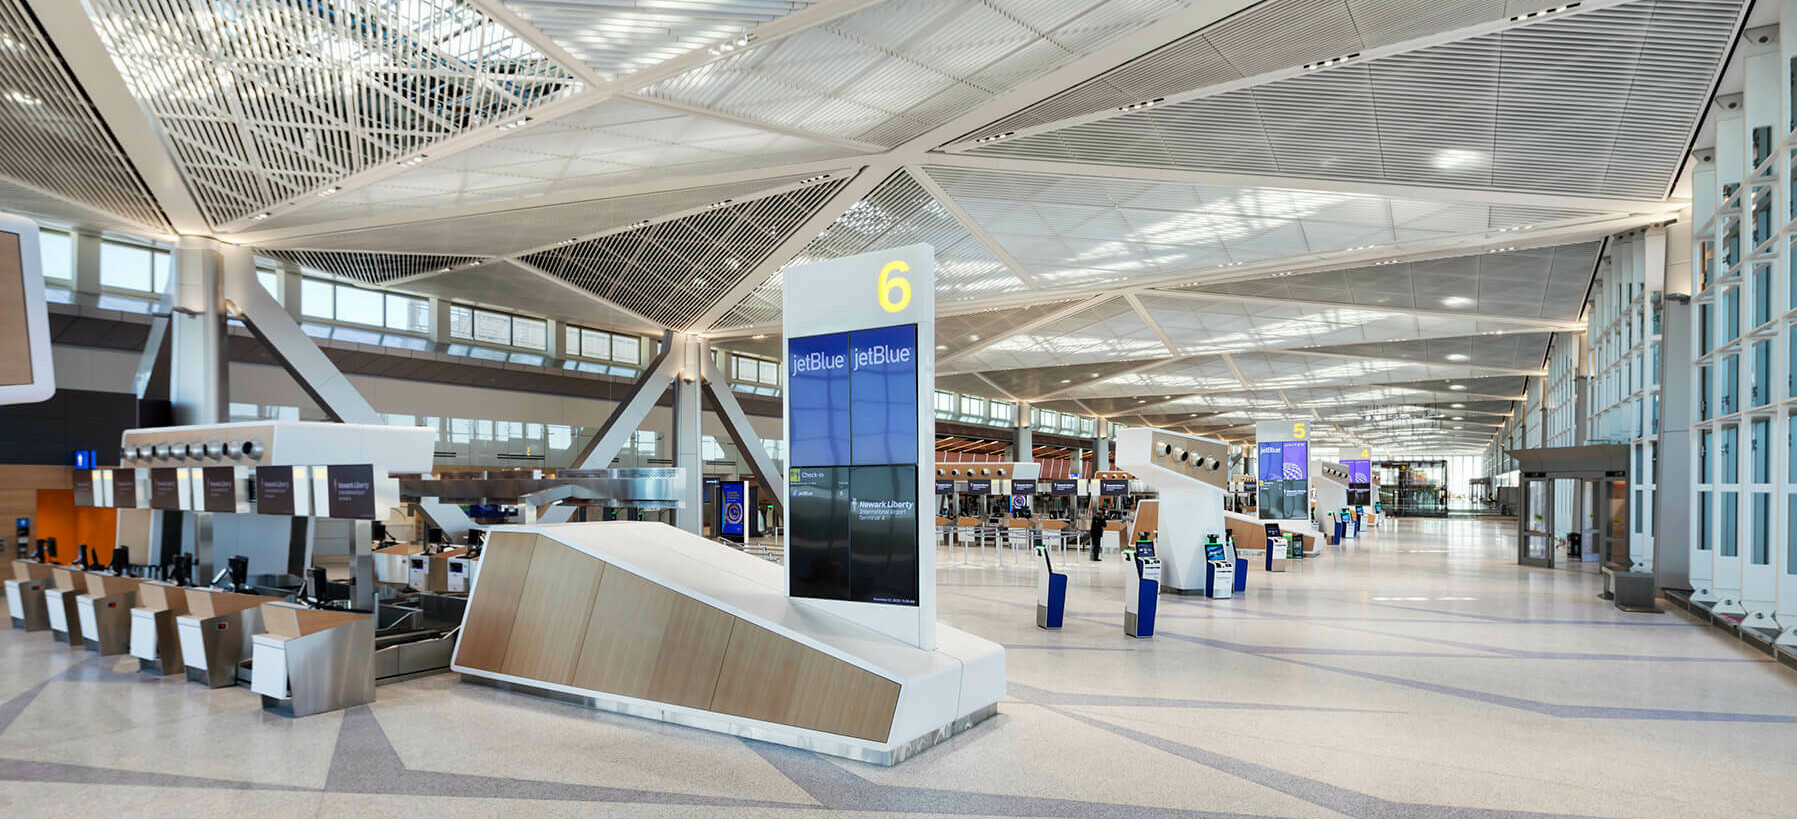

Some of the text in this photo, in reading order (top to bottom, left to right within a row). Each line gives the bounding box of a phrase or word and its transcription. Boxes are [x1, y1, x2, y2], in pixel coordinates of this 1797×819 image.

[878, 260, 912, 313] 6
[792, 352, 845, 377] jetBlue
[853, 345, 910, 371] jetBlue
[1293, 423, 1307, 438] 5
[1260, 446, 1281, 454] jetBlue
[1361, 449, 1369, 458] 4
[887, 500, 914, 510] Liberty
